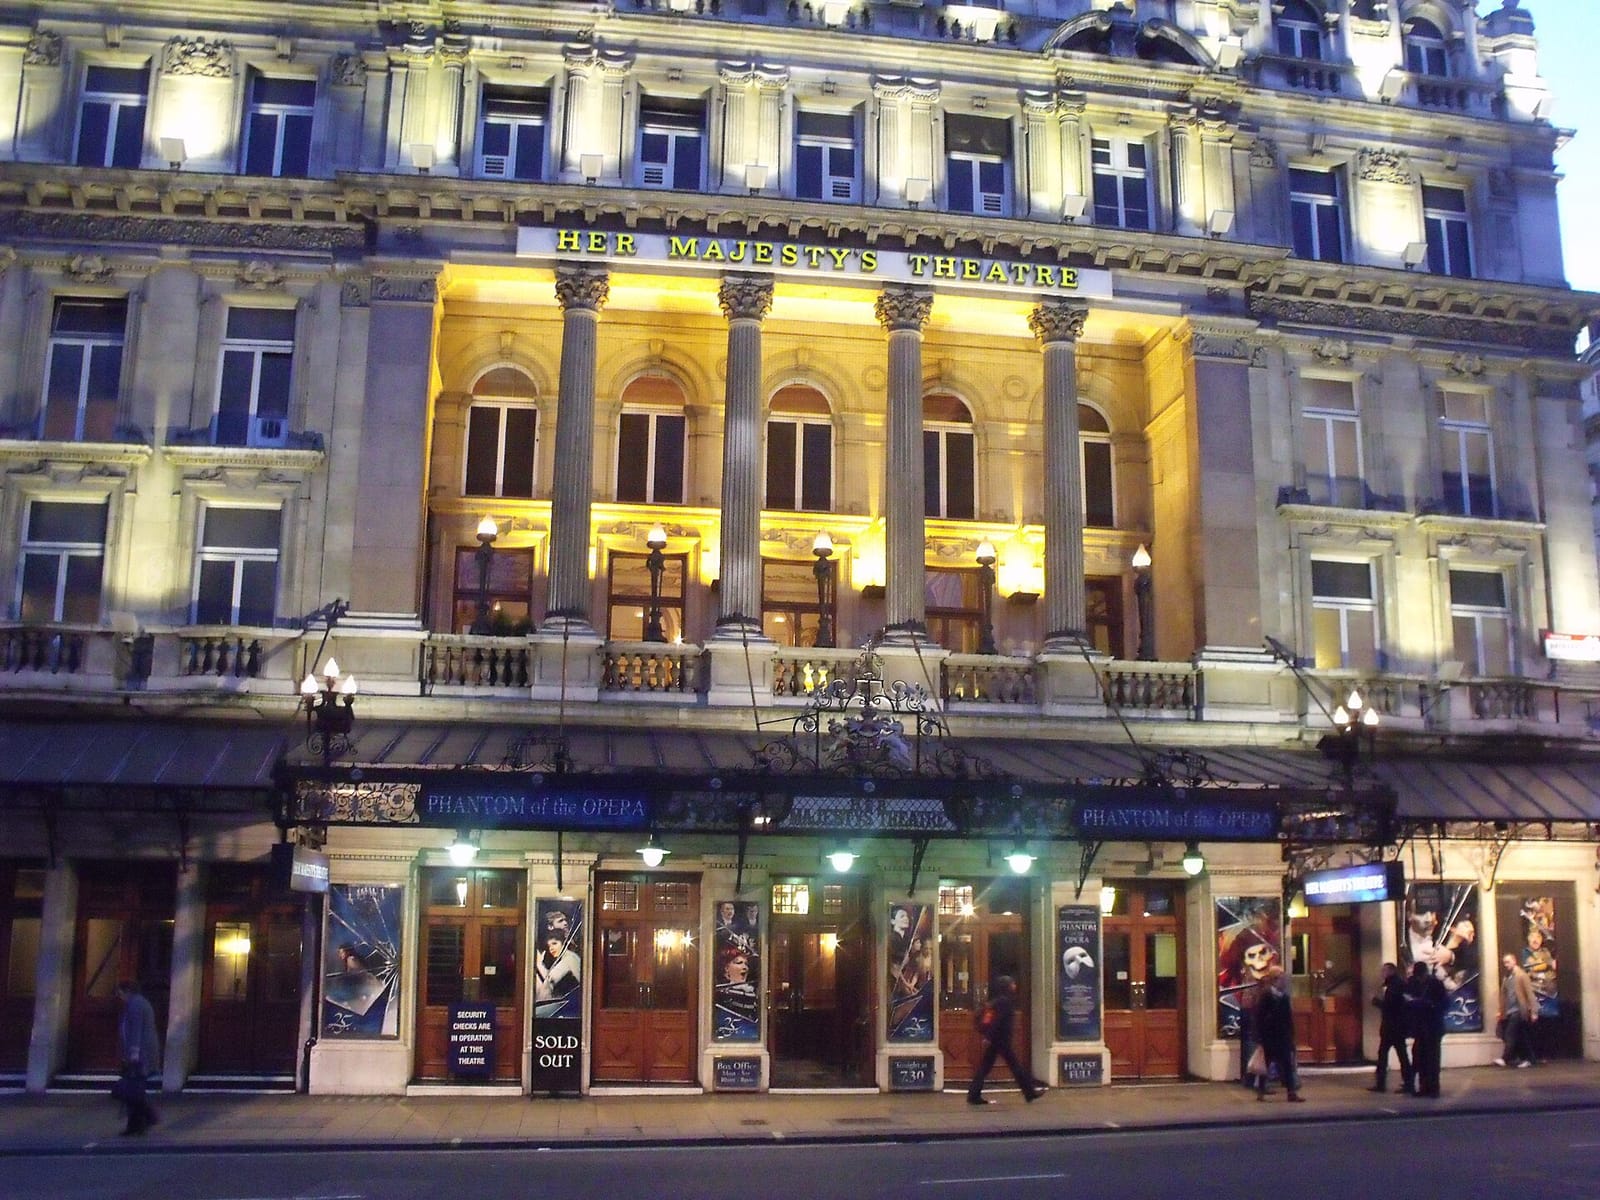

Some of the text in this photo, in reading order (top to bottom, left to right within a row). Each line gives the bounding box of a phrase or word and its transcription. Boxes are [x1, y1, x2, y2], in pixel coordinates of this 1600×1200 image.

[556, 229, 1080, 289] HER MAJESTY'S THEATRE
[427, 795, 646, 818] PHANTOM of the OPERA
[1082, 809, 1170, 829] PHANTOM
[1218, 811, 1273, 830] OPERA
[457, 1011, 487, 1019] SECURITY
[453, 1022, 491, 1030] CHECKS ARE
[451, 1034, 492, 1042] IN OPERATION
[535, 1035, 578, 1049] SOLD
[460, 1046, 468, 1054] AT
[458, 1057, 485, 1065] THEATRE
[539, 1055, 574, 1068] OUT
[717, 1062, 731, 1070] Box
[1064, 1061, 1097, 1070] HOUSE
